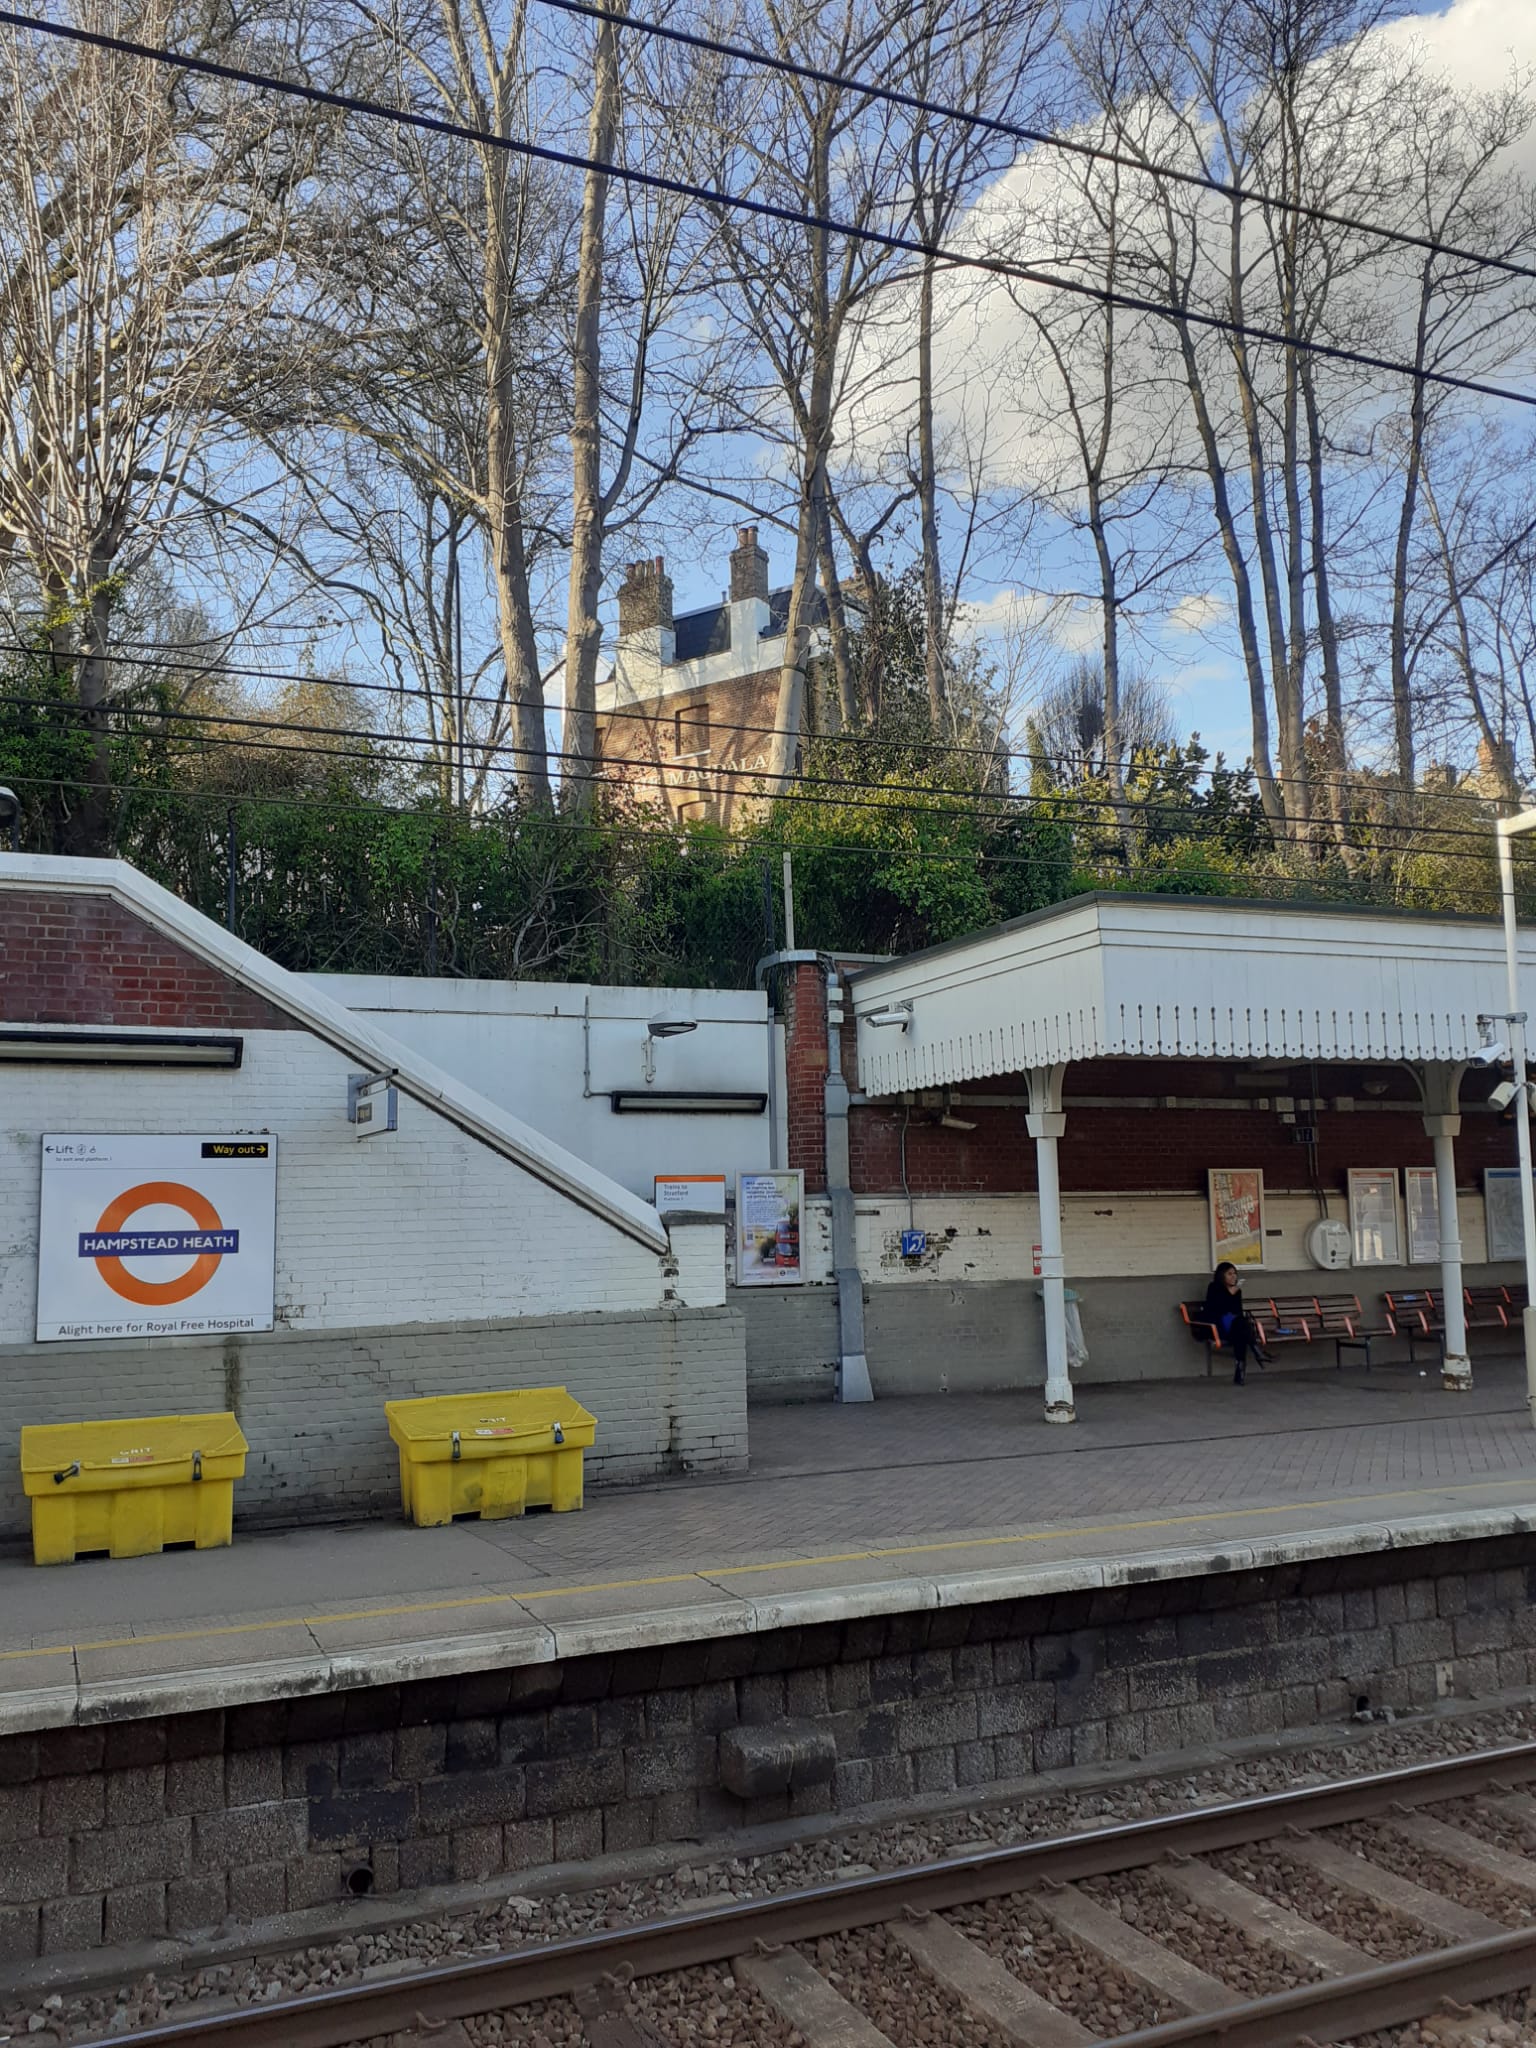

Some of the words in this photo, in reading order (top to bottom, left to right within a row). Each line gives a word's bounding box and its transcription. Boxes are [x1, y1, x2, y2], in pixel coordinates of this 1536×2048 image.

[669, 755, 768, 786] MAGDALA
[55, 1145, 74, 1154] Lift
[213, 1145, 235, 1156] Way
[237, 1146, 256, 1154] out
[84, 1238, 179, 1250] HAMPSTEAD
[183, 1236, 234, 1248] HEATH
[58, 1324, 93, 1336] Alight
[97, 1324, 125, 1334] here
[126, 1322, 143, 1333] for
[147, 1321, 177, 1333] Royal
[180, 1320, 205, 1331] Free
[207, 1318, 254, 1330] Hospital
